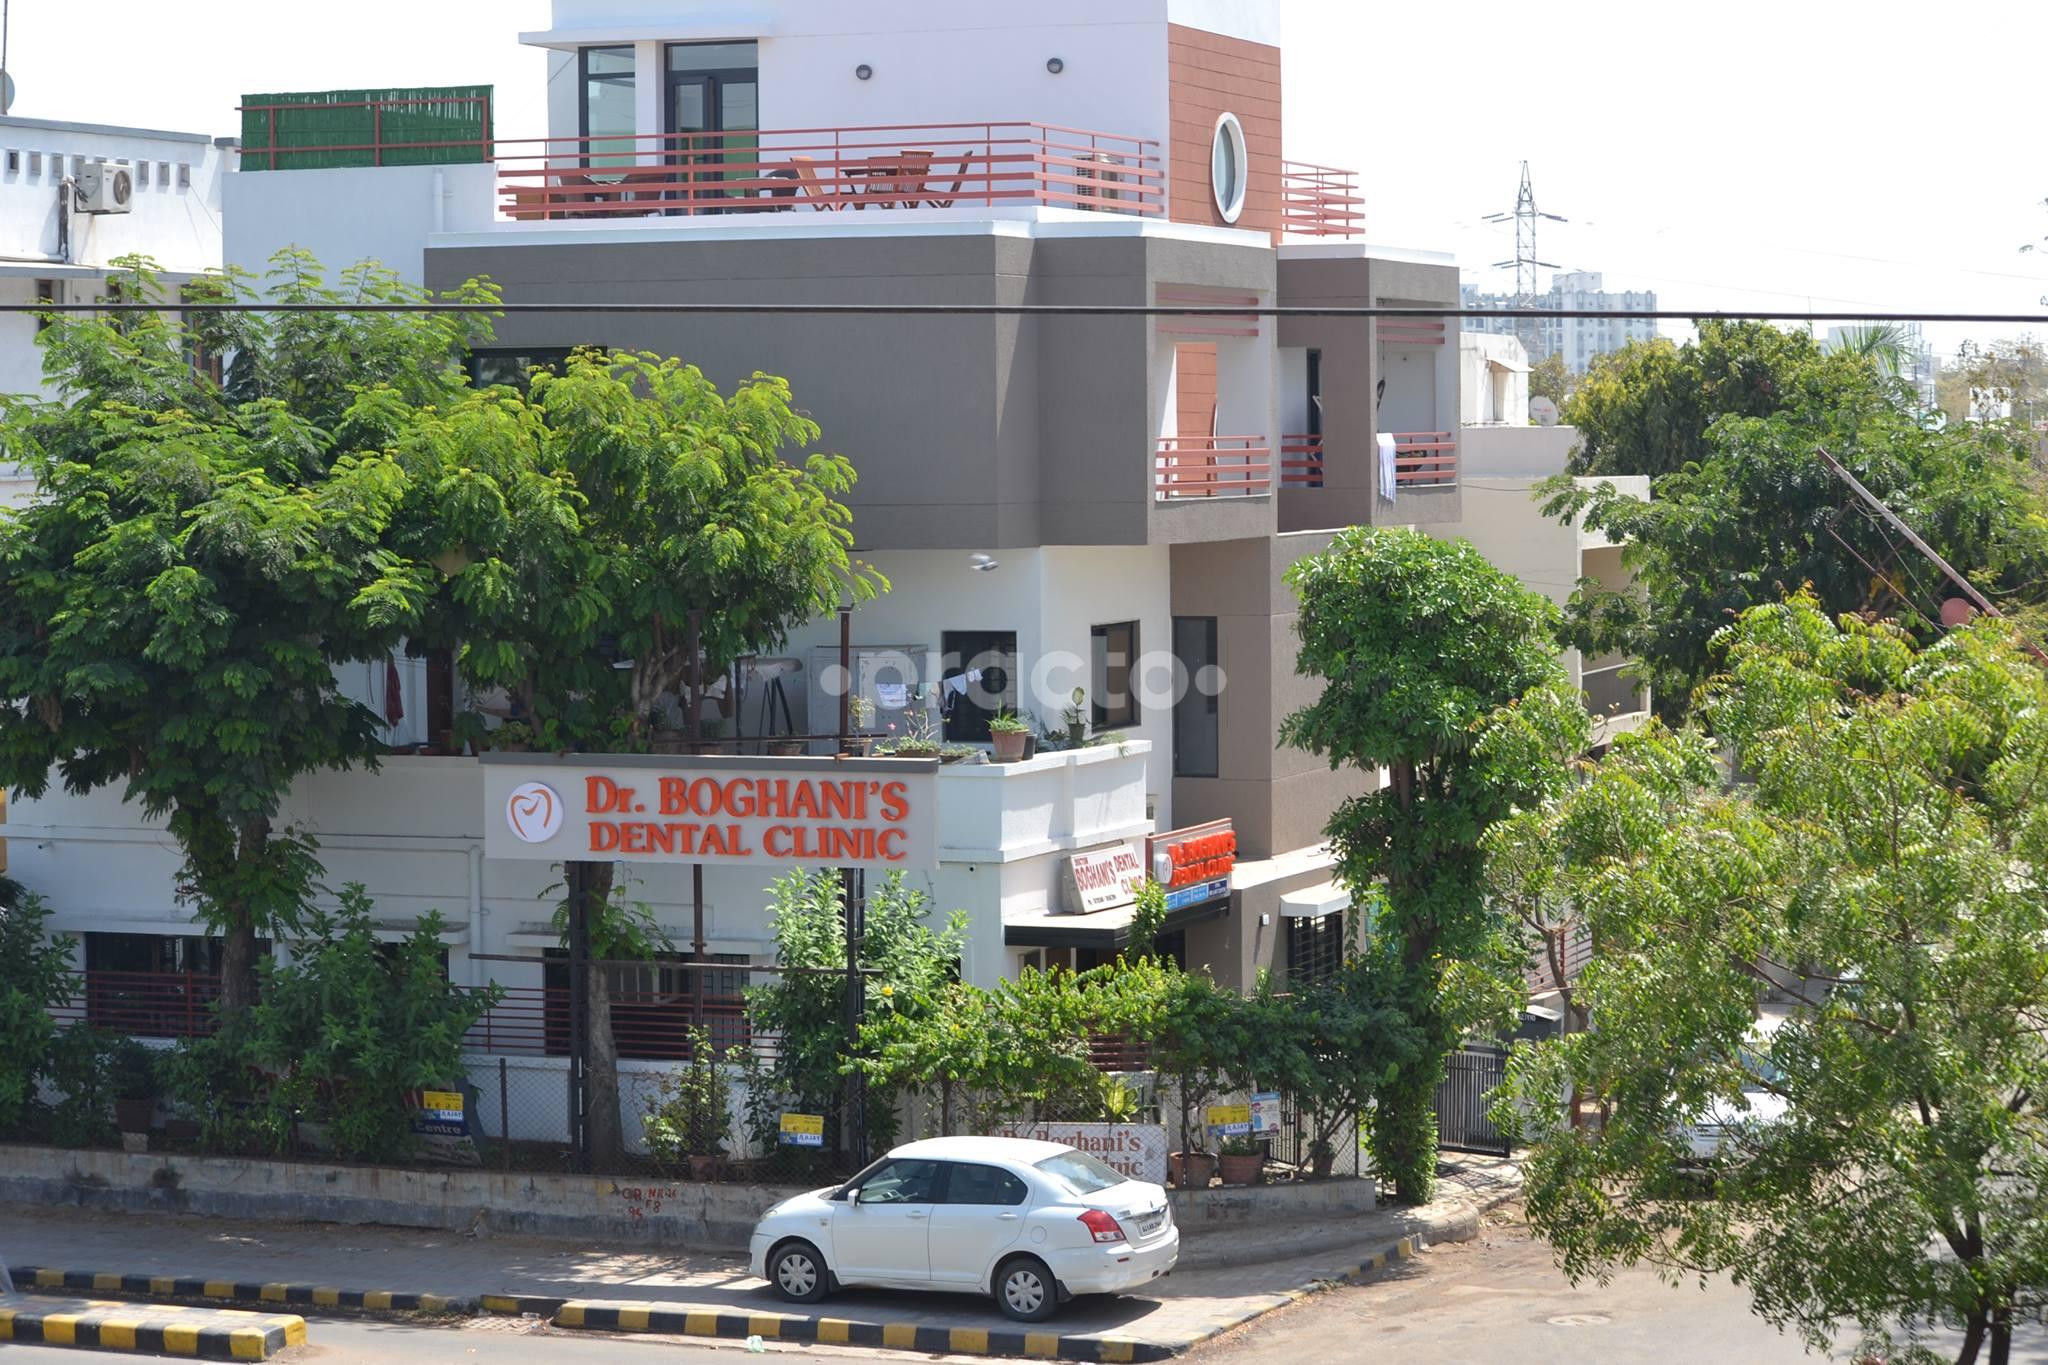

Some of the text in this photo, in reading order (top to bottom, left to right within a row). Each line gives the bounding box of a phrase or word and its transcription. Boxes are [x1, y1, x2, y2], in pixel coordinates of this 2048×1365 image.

[584, 775, 911, 822] Dr. BOGHANI'S
[588, 822, 908, 861] DENTAL CLINIC
[1112, 852, 1140, 873] DENTAL
[415, 1123, 462, 1134] Centre
